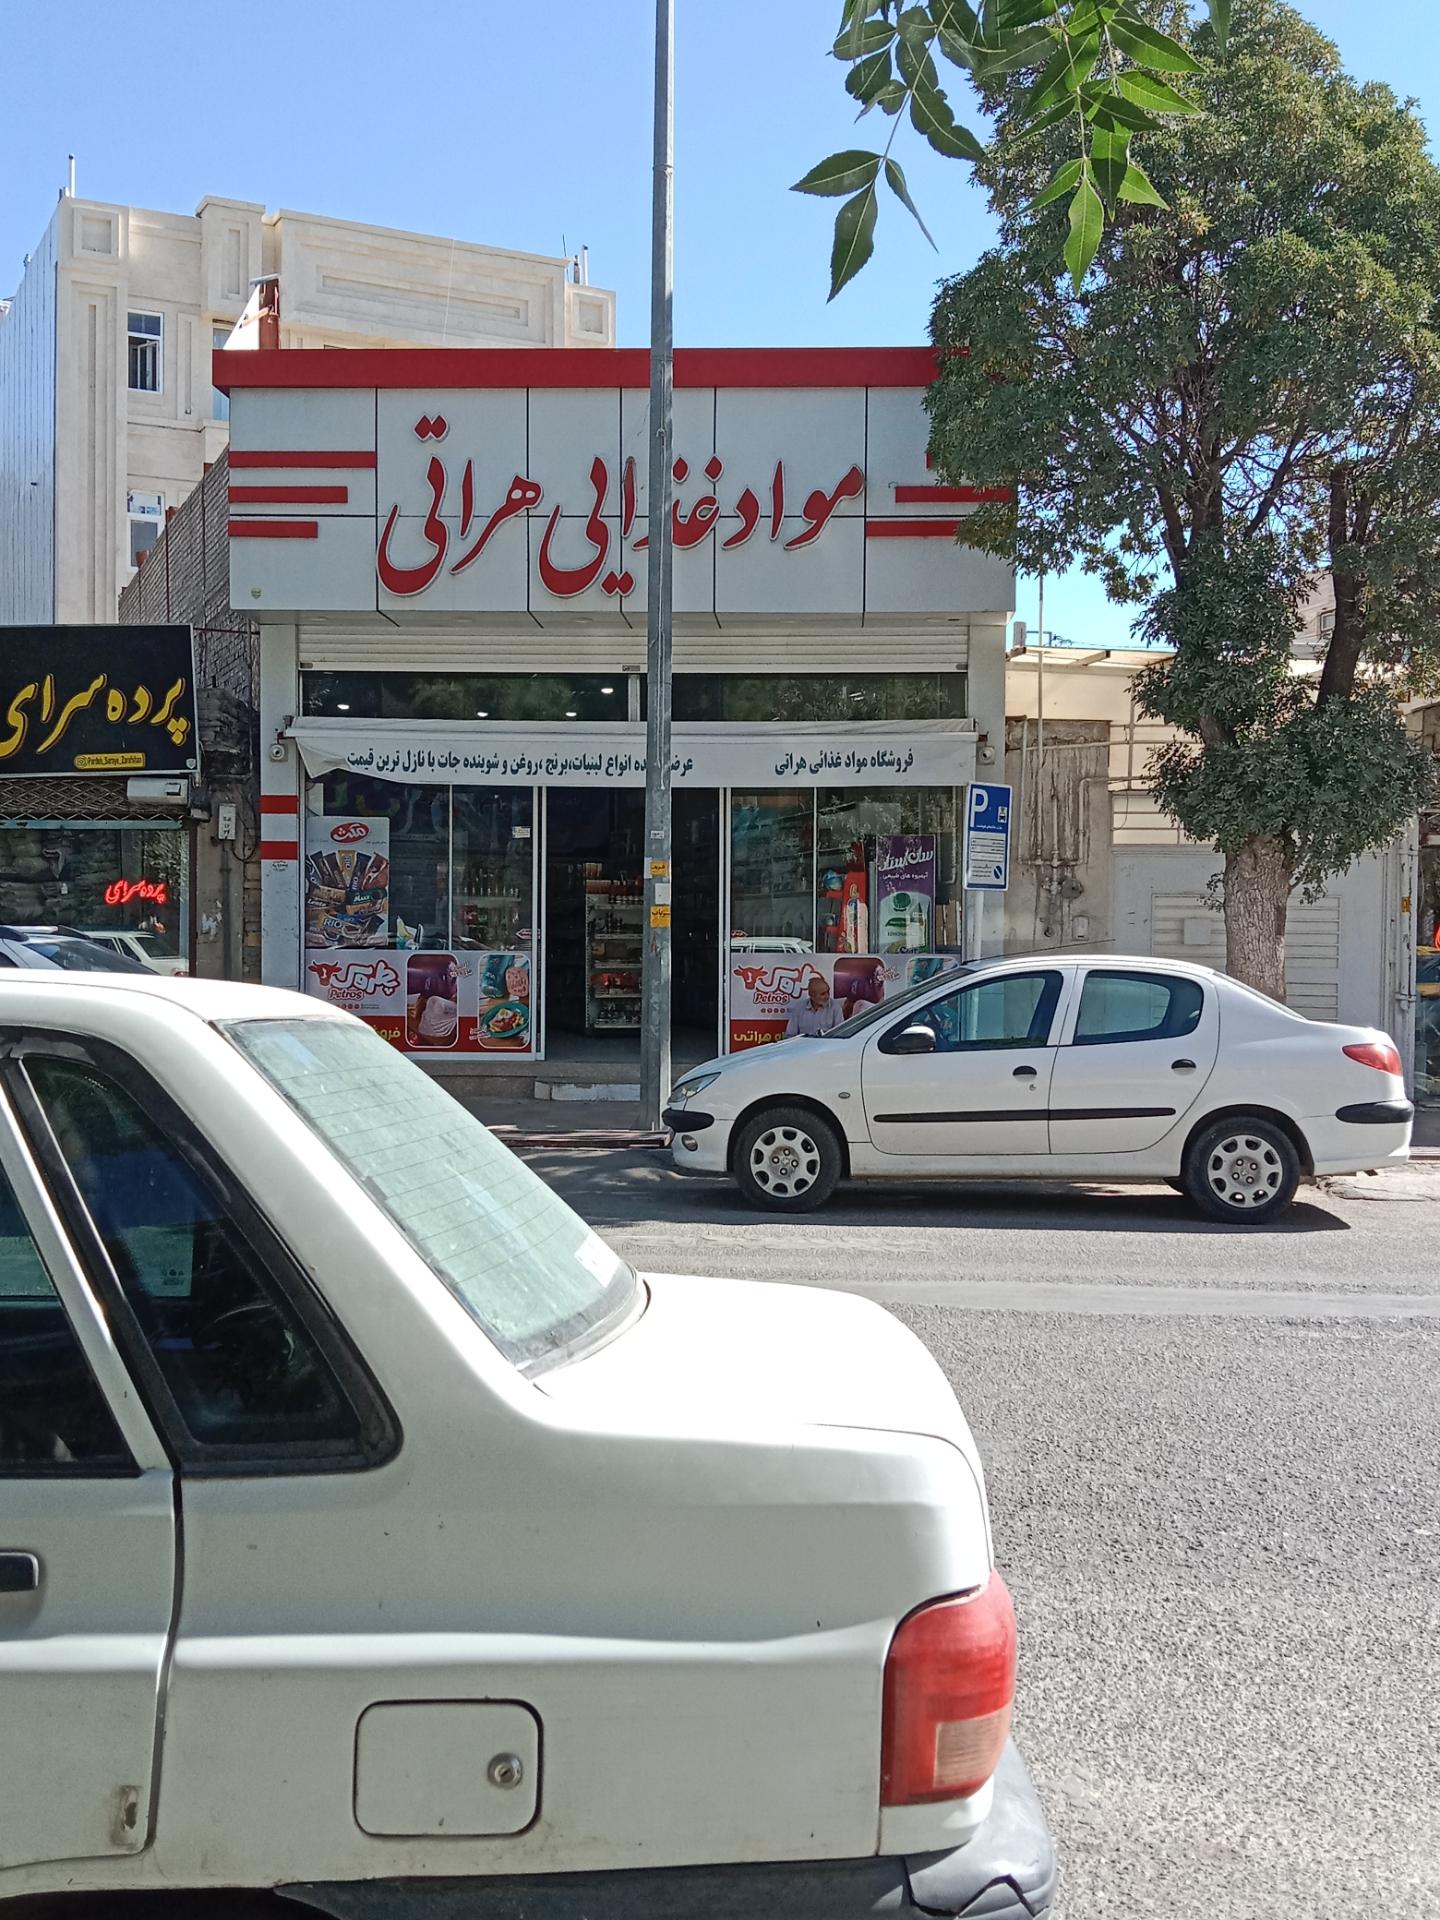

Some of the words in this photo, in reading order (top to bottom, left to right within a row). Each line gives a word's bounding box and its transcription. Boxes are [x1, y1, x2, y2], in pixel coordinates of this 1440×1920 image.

[376, 413, 544, 598] هراتی
[721, 458, 866, 551] مواد
[107, 676, 187, 746] پرده
[346, 748, 374, 770] قیمت
[376, 750, 400, 773] ترین
[402, 749, 425, 773] نازل
[427, 750, 435, 772] با
[438, 751, 461, 773] جات
[463, 753, 500, 775] شوینده
[500, 759, 508, 775] و
[605, 753, 631, 777] انواع
[671, 754, 693, 777] عرض
[774, 752, 807, 776] هراتی
[844, 751, 868, 774] مواد
[870, 748, 914, 774] فروشگاه
[970, 788, 989, 828] P
[323, 918, 343, 929] RIO
[329, 988, 364, 1000] Petros
[754, 992, 789, 1005] Petros
[733, 1030, 772, 1044] هراتی
